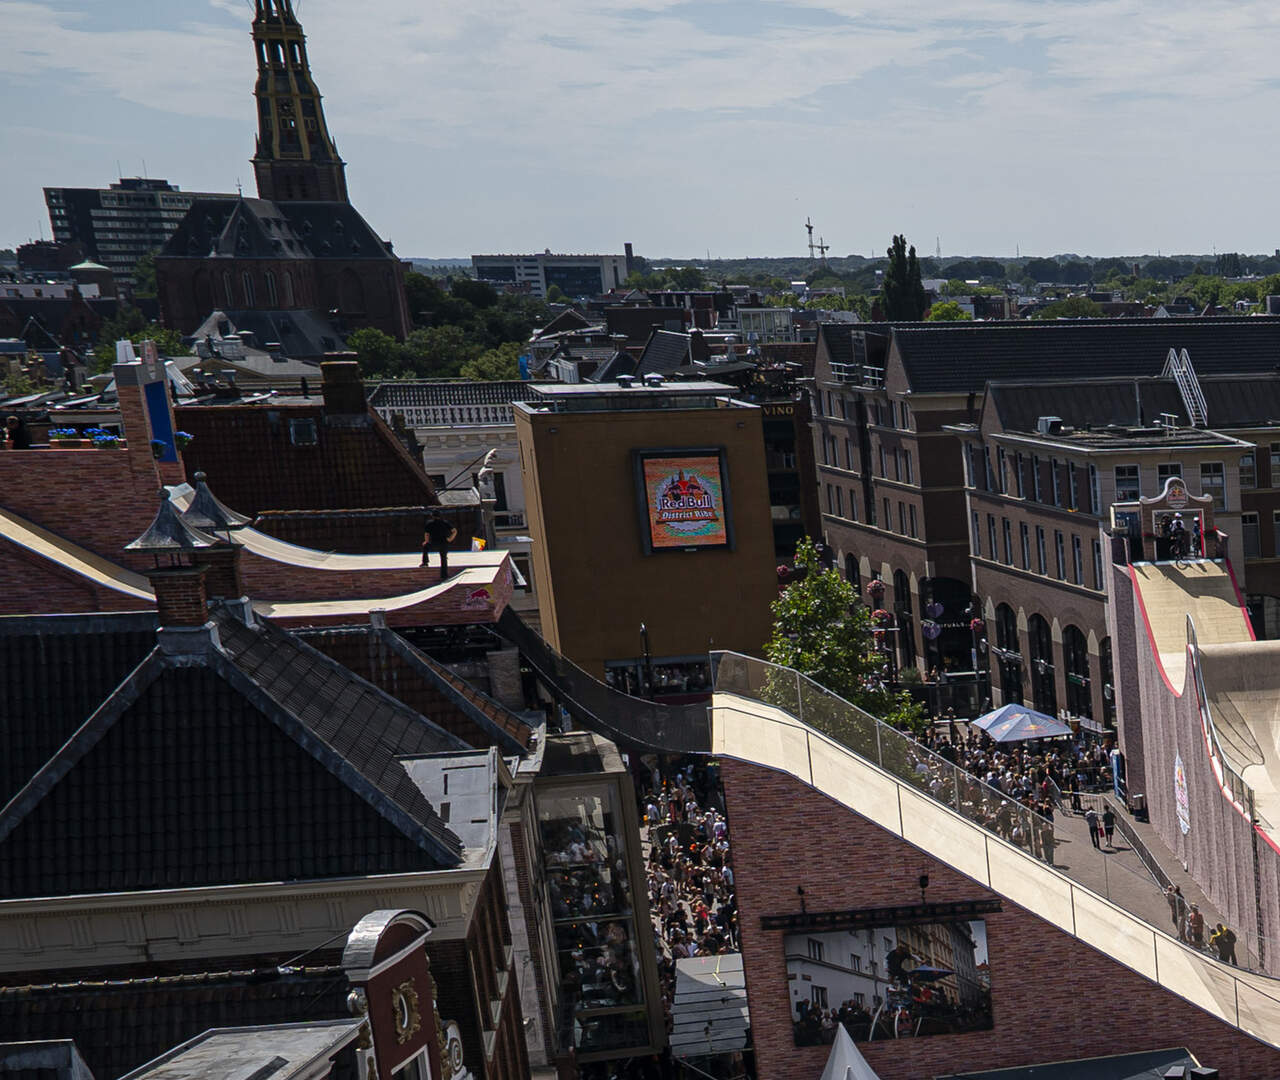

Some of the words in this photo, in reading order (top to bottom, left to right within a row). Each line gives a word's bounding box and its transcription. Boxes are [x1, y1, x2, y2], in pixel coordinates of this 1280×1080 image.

[763, 406, 794, 416] VINO
[661, 495, 686, 509] Red
[687, 494, 713, 508] Bull
[662, 510, 692, 520] District
